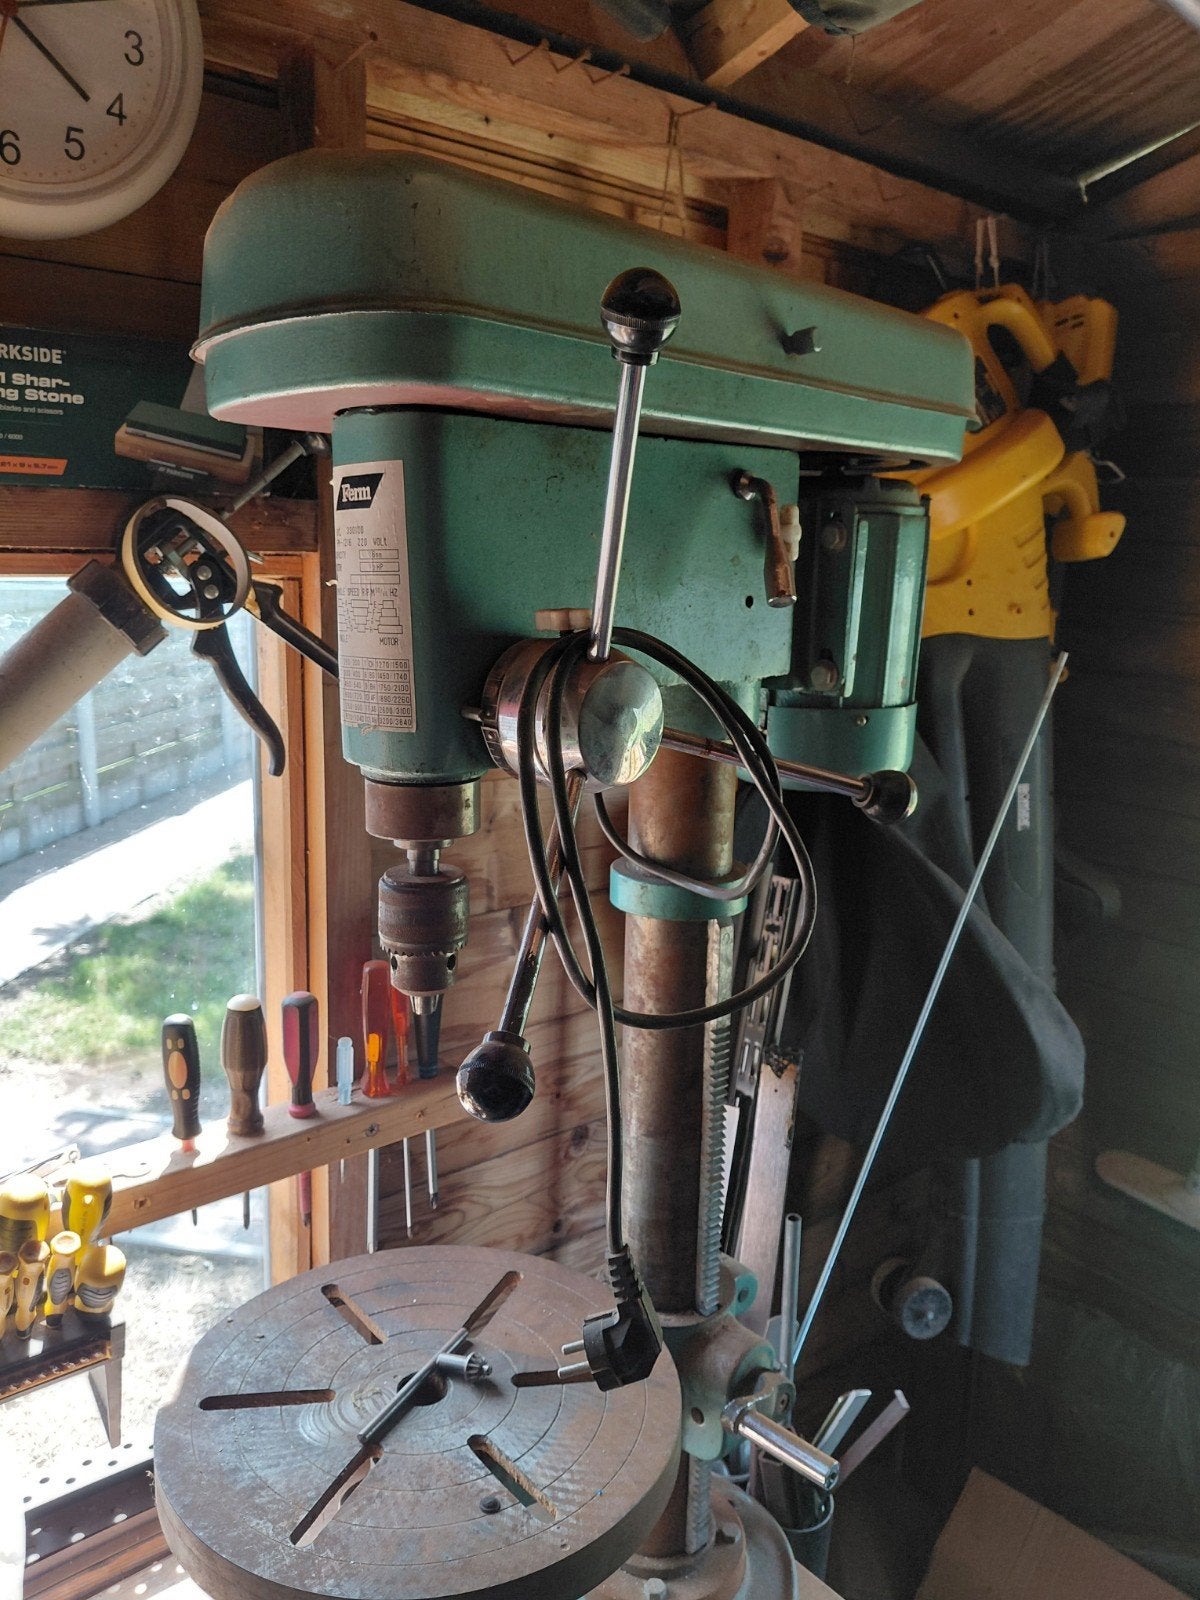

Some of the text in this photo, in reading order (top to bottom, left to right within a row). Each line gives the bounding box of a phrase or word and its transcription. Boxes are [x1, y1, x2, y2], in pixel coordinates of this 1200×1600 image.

[124, 30, 144, 66] 3
[106, 92, 127, 126] 4
[0, 129, 21, 165] 6
[64, 126, 85, 161] 5
[12, 372, 70, 389] Shar-
[25, 388, 85, 405] Stone
[341, 483, 372, 502] Ferm
[379, 637, 399, 646] MOTOR
